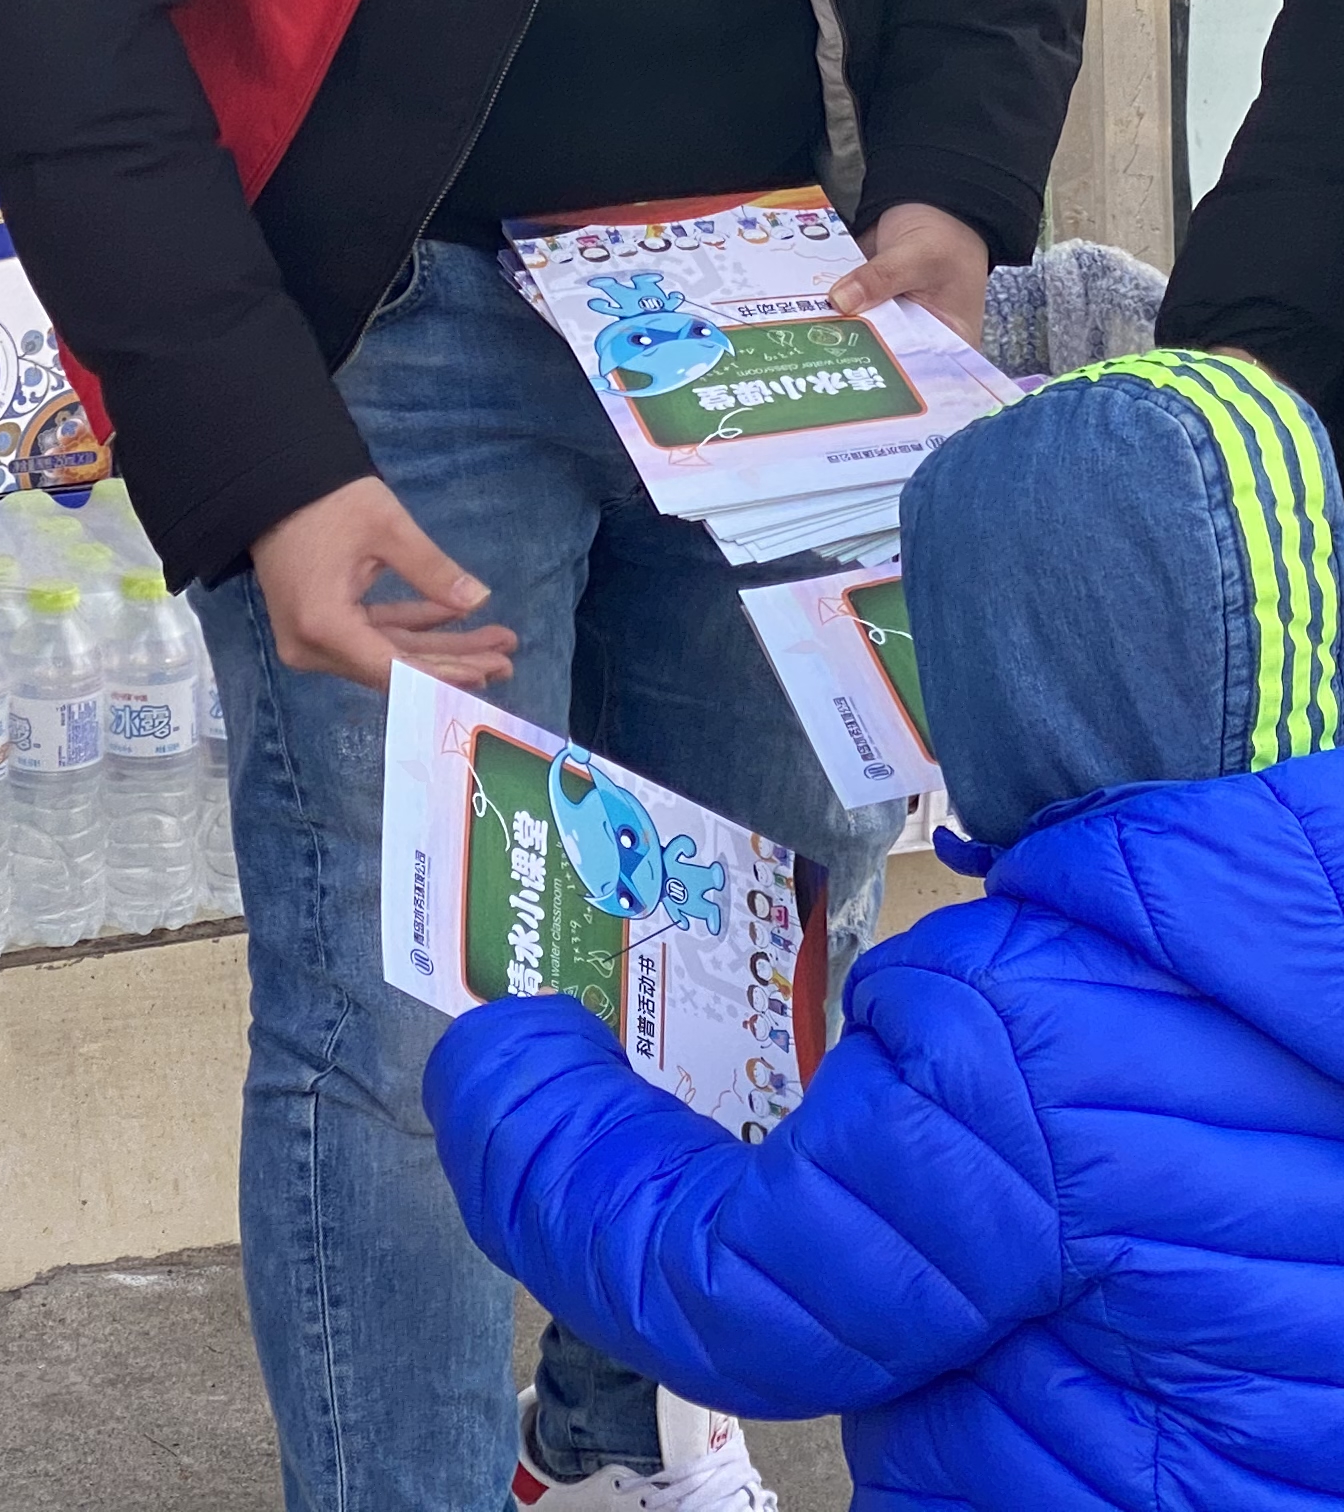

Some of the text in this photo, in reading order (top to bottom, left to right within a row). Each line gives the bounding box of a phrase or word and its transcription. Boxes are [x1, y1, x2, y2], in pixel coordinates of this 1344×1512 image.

[692, 368, 886, 411] 清水小课堂
[507, 810, 550, 998] 清水小课堂
[636, 953, 657, 1059] 科普活动书
